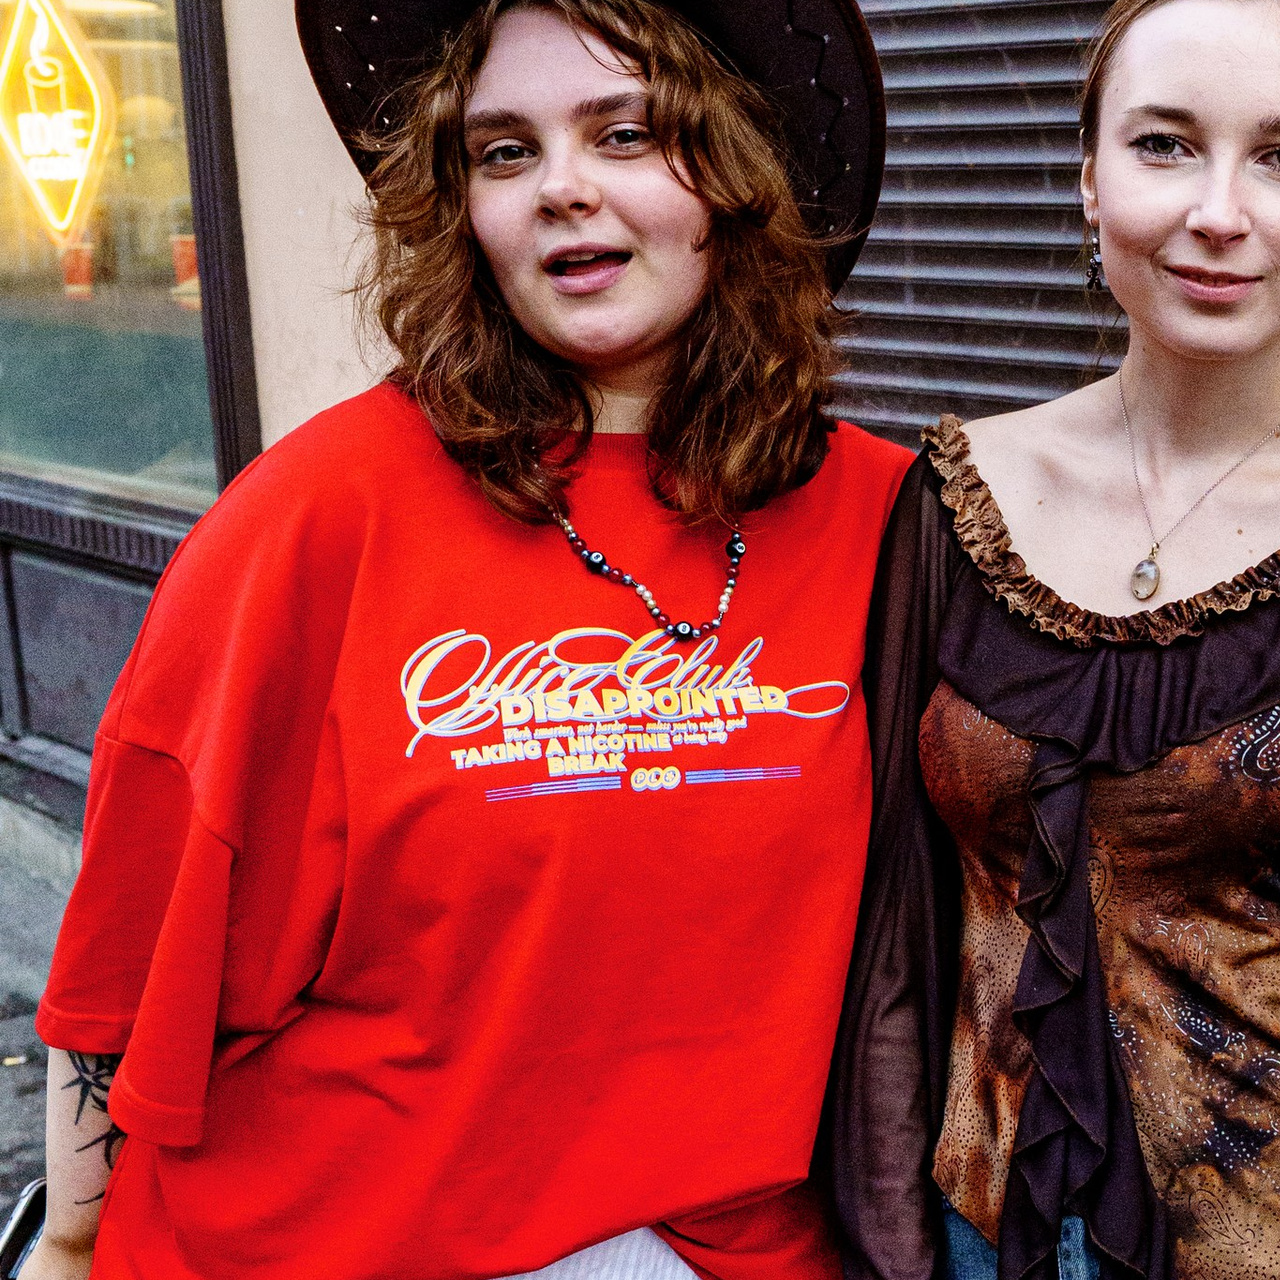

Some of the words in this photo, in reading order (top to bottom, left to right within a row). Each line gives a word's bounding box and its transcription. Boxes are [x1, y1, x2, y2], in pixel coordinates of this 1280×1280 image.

[400, 627, 624, 758] Office
[614, 627, 766, 700] Club
[499, 685, 790, 726] DISAPPOINTED
[577, 723, 594, 736] not
[450, 740, 542, 769] TAKING
[545, 737, 566, 758] A
[568, 733, 673, 756] NICOTINE
[546, 752, 627, 777] BREAK
